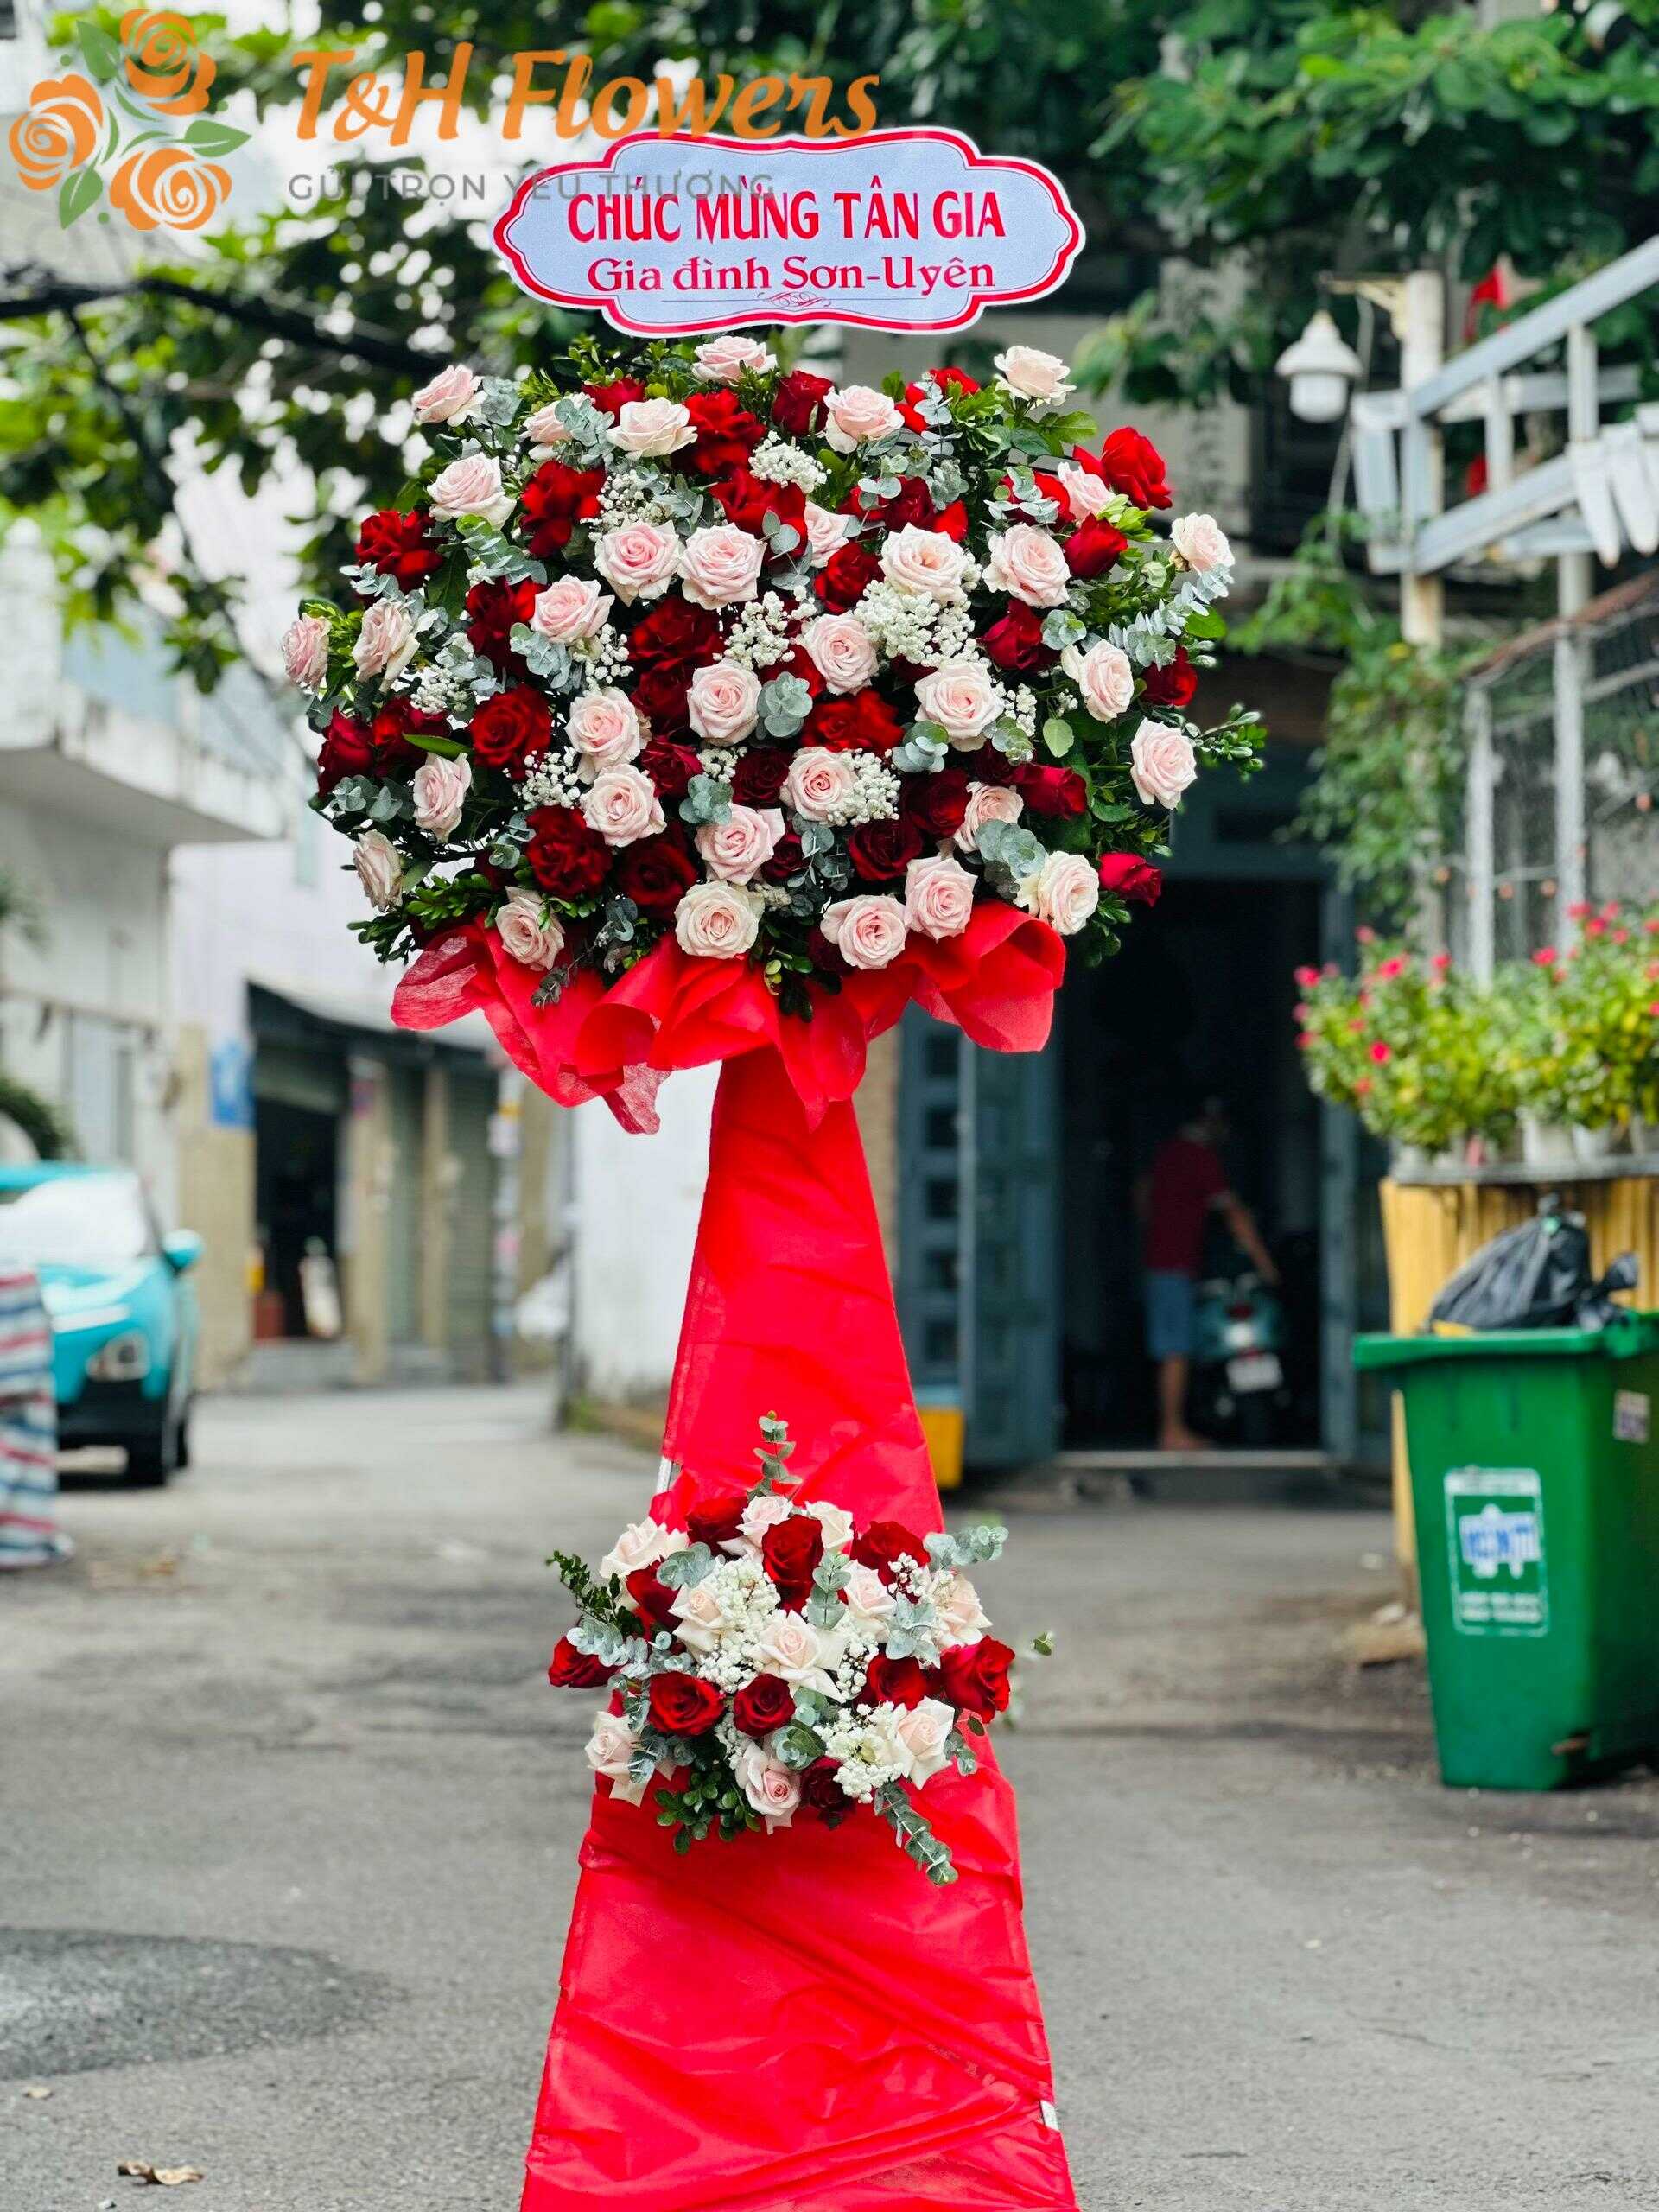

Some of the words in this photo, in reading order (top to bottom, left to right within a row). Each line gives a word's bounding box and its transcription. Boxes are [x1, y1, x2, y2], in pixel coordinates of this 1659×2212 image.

[568, 176, 682, 244] CHÚC
[696, 175, 819, 244] MỪNG
[833, 175, 918, 241] TÂN
[932, 190, 1006, 239] GIA
[588, 257, 664, 291] Gia
[672, 256, 771, 290] đình
[781, 256, 995, 296] Sơn-Uyên
